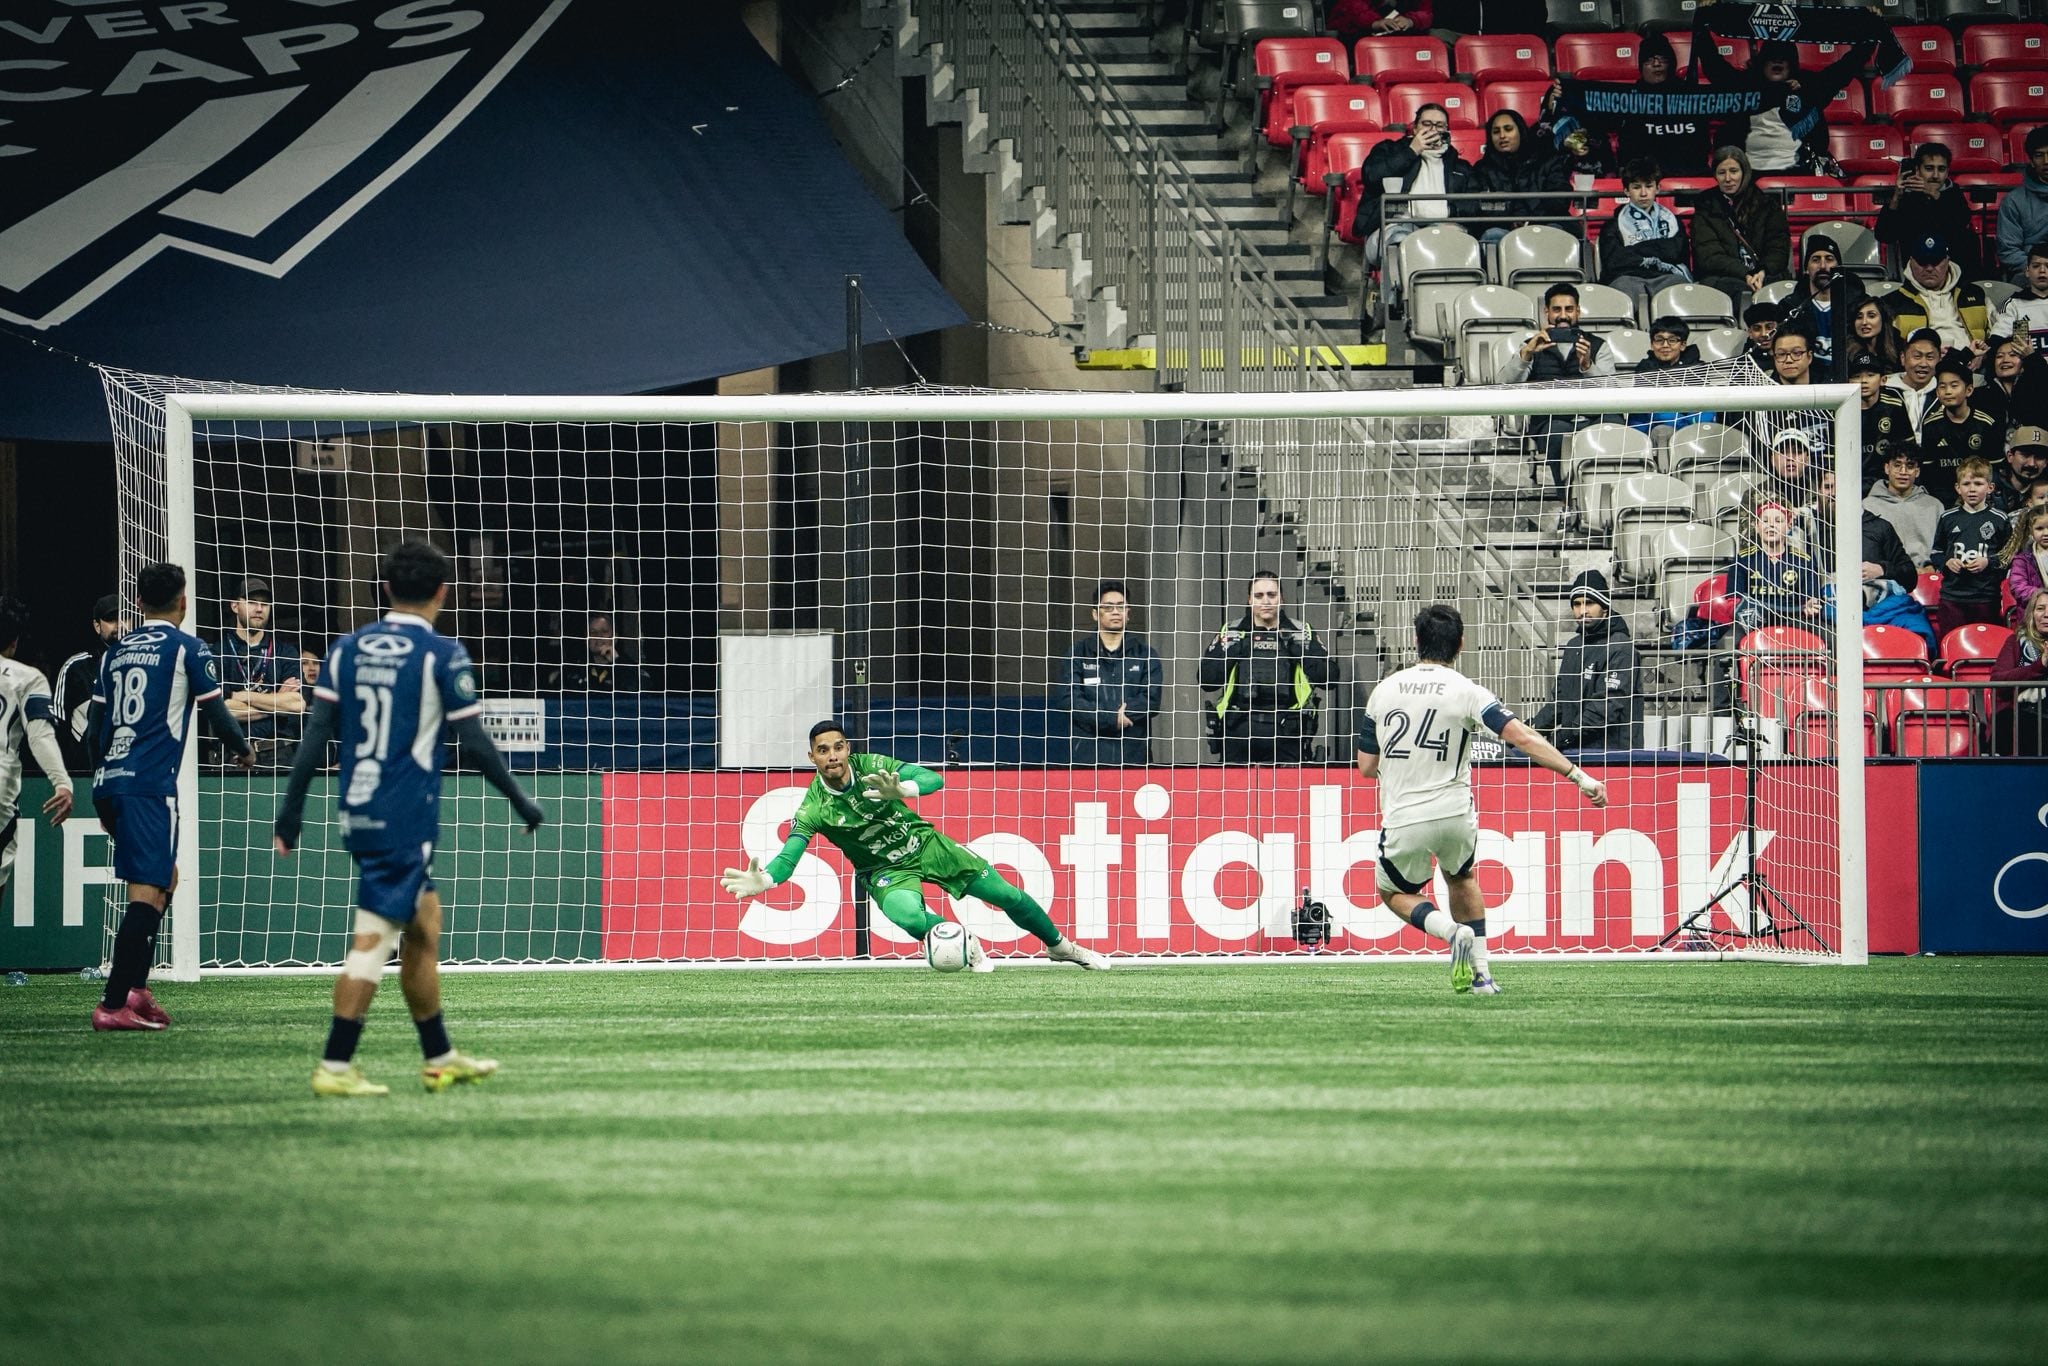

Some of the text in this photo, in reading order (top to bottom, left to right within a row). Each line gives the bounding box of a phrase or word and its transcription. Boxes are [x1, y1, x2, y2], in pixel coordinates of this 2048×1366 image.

[1752, 18, 1797, 27] WHITECAPS
[1667, 93, 1742, 115] WHITECAPS
[1744, 91, 1761, 111] FC
[1646, 123, 1696, 135] TELUS
[1954, 543, 1988, 568] Bell
[112, 667, 148, 726] 18
[1399, 682, 1446, 696] WHITE
[355, 685, 393, 762] 31
[1384, 708, 1450, 762] 24
[1471, 741, 1502, 753] BIRD
